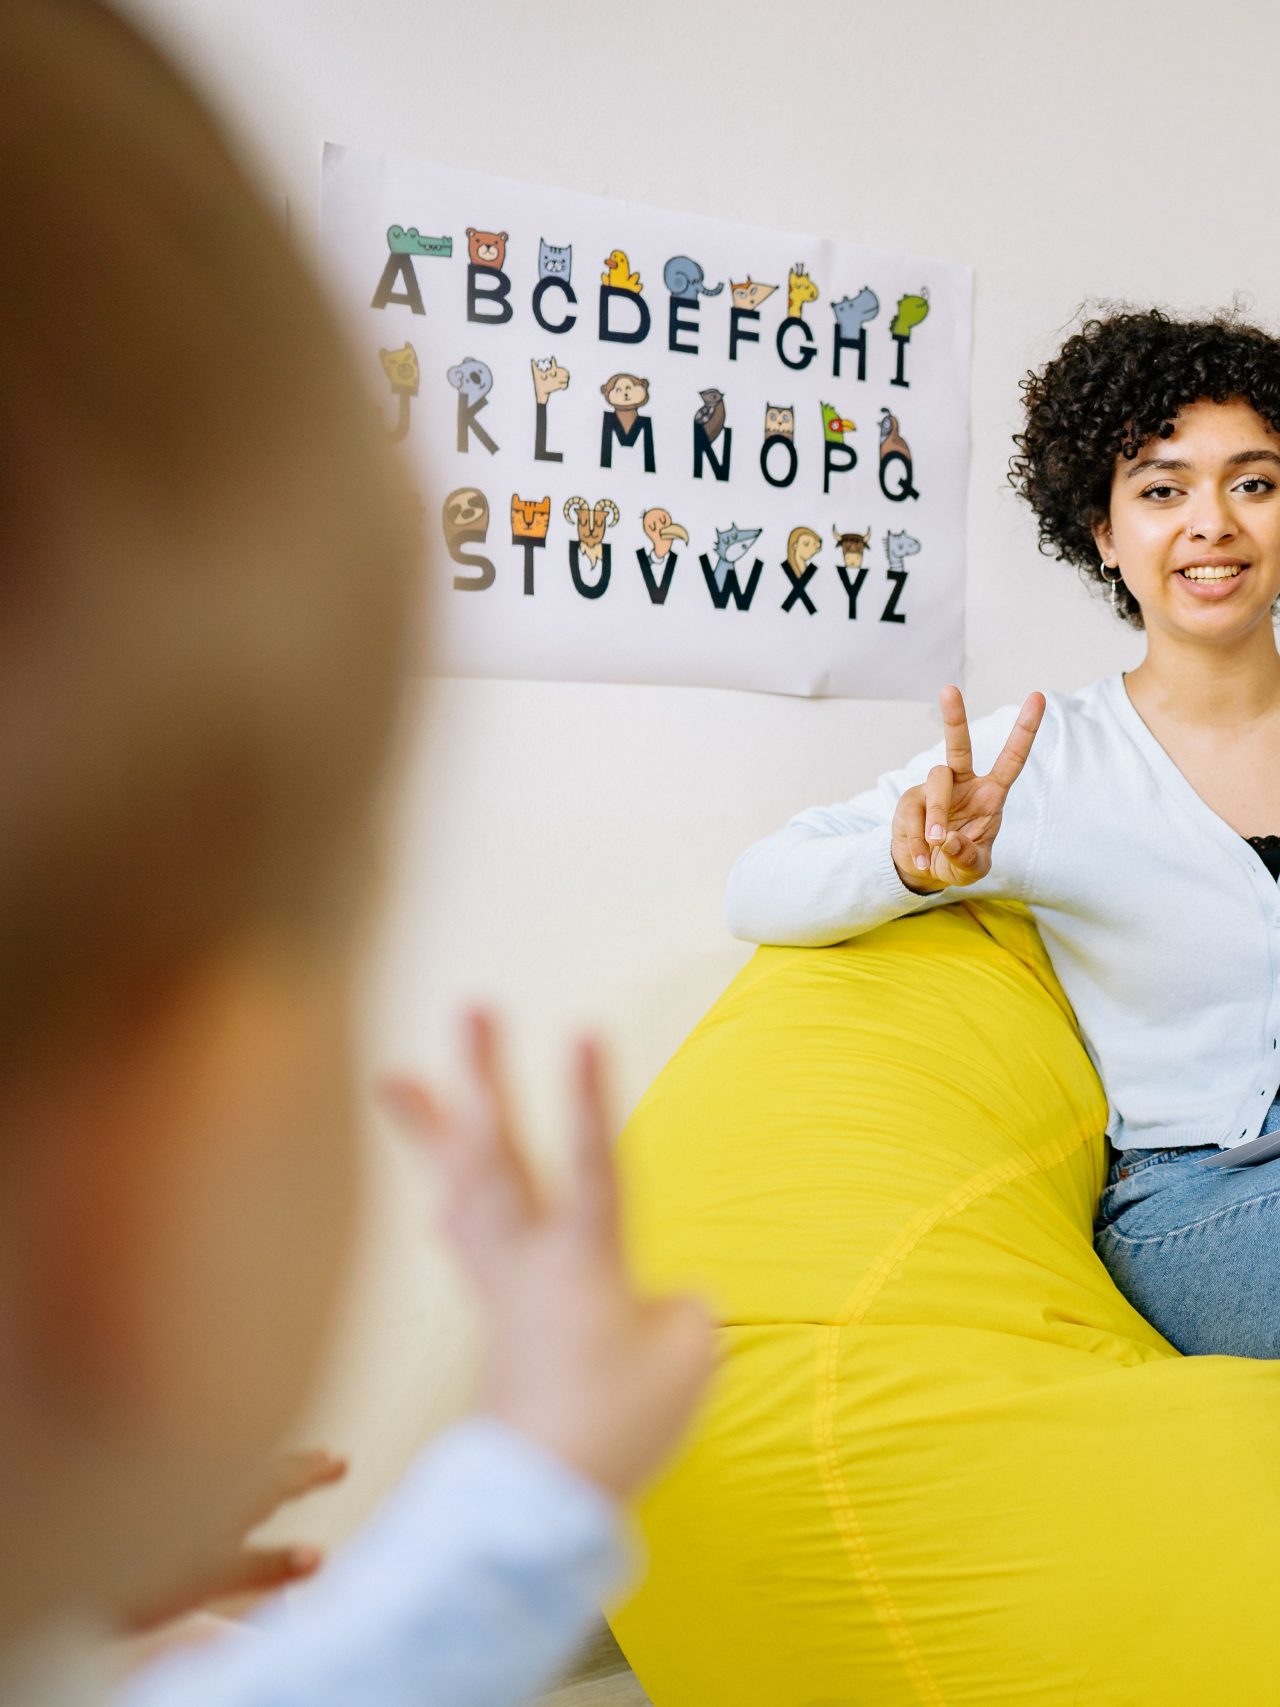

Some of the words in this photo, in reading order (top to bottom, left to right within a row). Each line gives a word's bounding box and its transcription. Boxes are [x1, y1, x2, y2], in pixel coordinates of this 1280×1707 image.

[371, 254, 426, 315] A
[467, 264, 513, 324] B
[532, 276, 577, 334] C
[599, 285, 651, 344] D
[669, 298, 700, 354] E
[729, 307, 760, 361] F
[776, 317, 818, 371] G
[833, 324, 867, 381] H
[890, 334, 910, 387] I
[457, 393, 500, 456] K
[534, 403, 563, 463] L
[600, 411, 657, 473] M
[694, 421, 732, 482] N
[760, 433, 798, 488] O
[823, 442, 857, 493] P
[879, 450, 921, 503] Q
[450, 530, 496, 592] S
[511, 535, 546, 595] T
[569, 539, 612, 599] U
[636, 546, 678, 605] V
[700, 551, 764, 611] W
[780, 560, 818, 616] X
[836, 567, 868, 620] Y
[879, 570, 908, 624] Z
